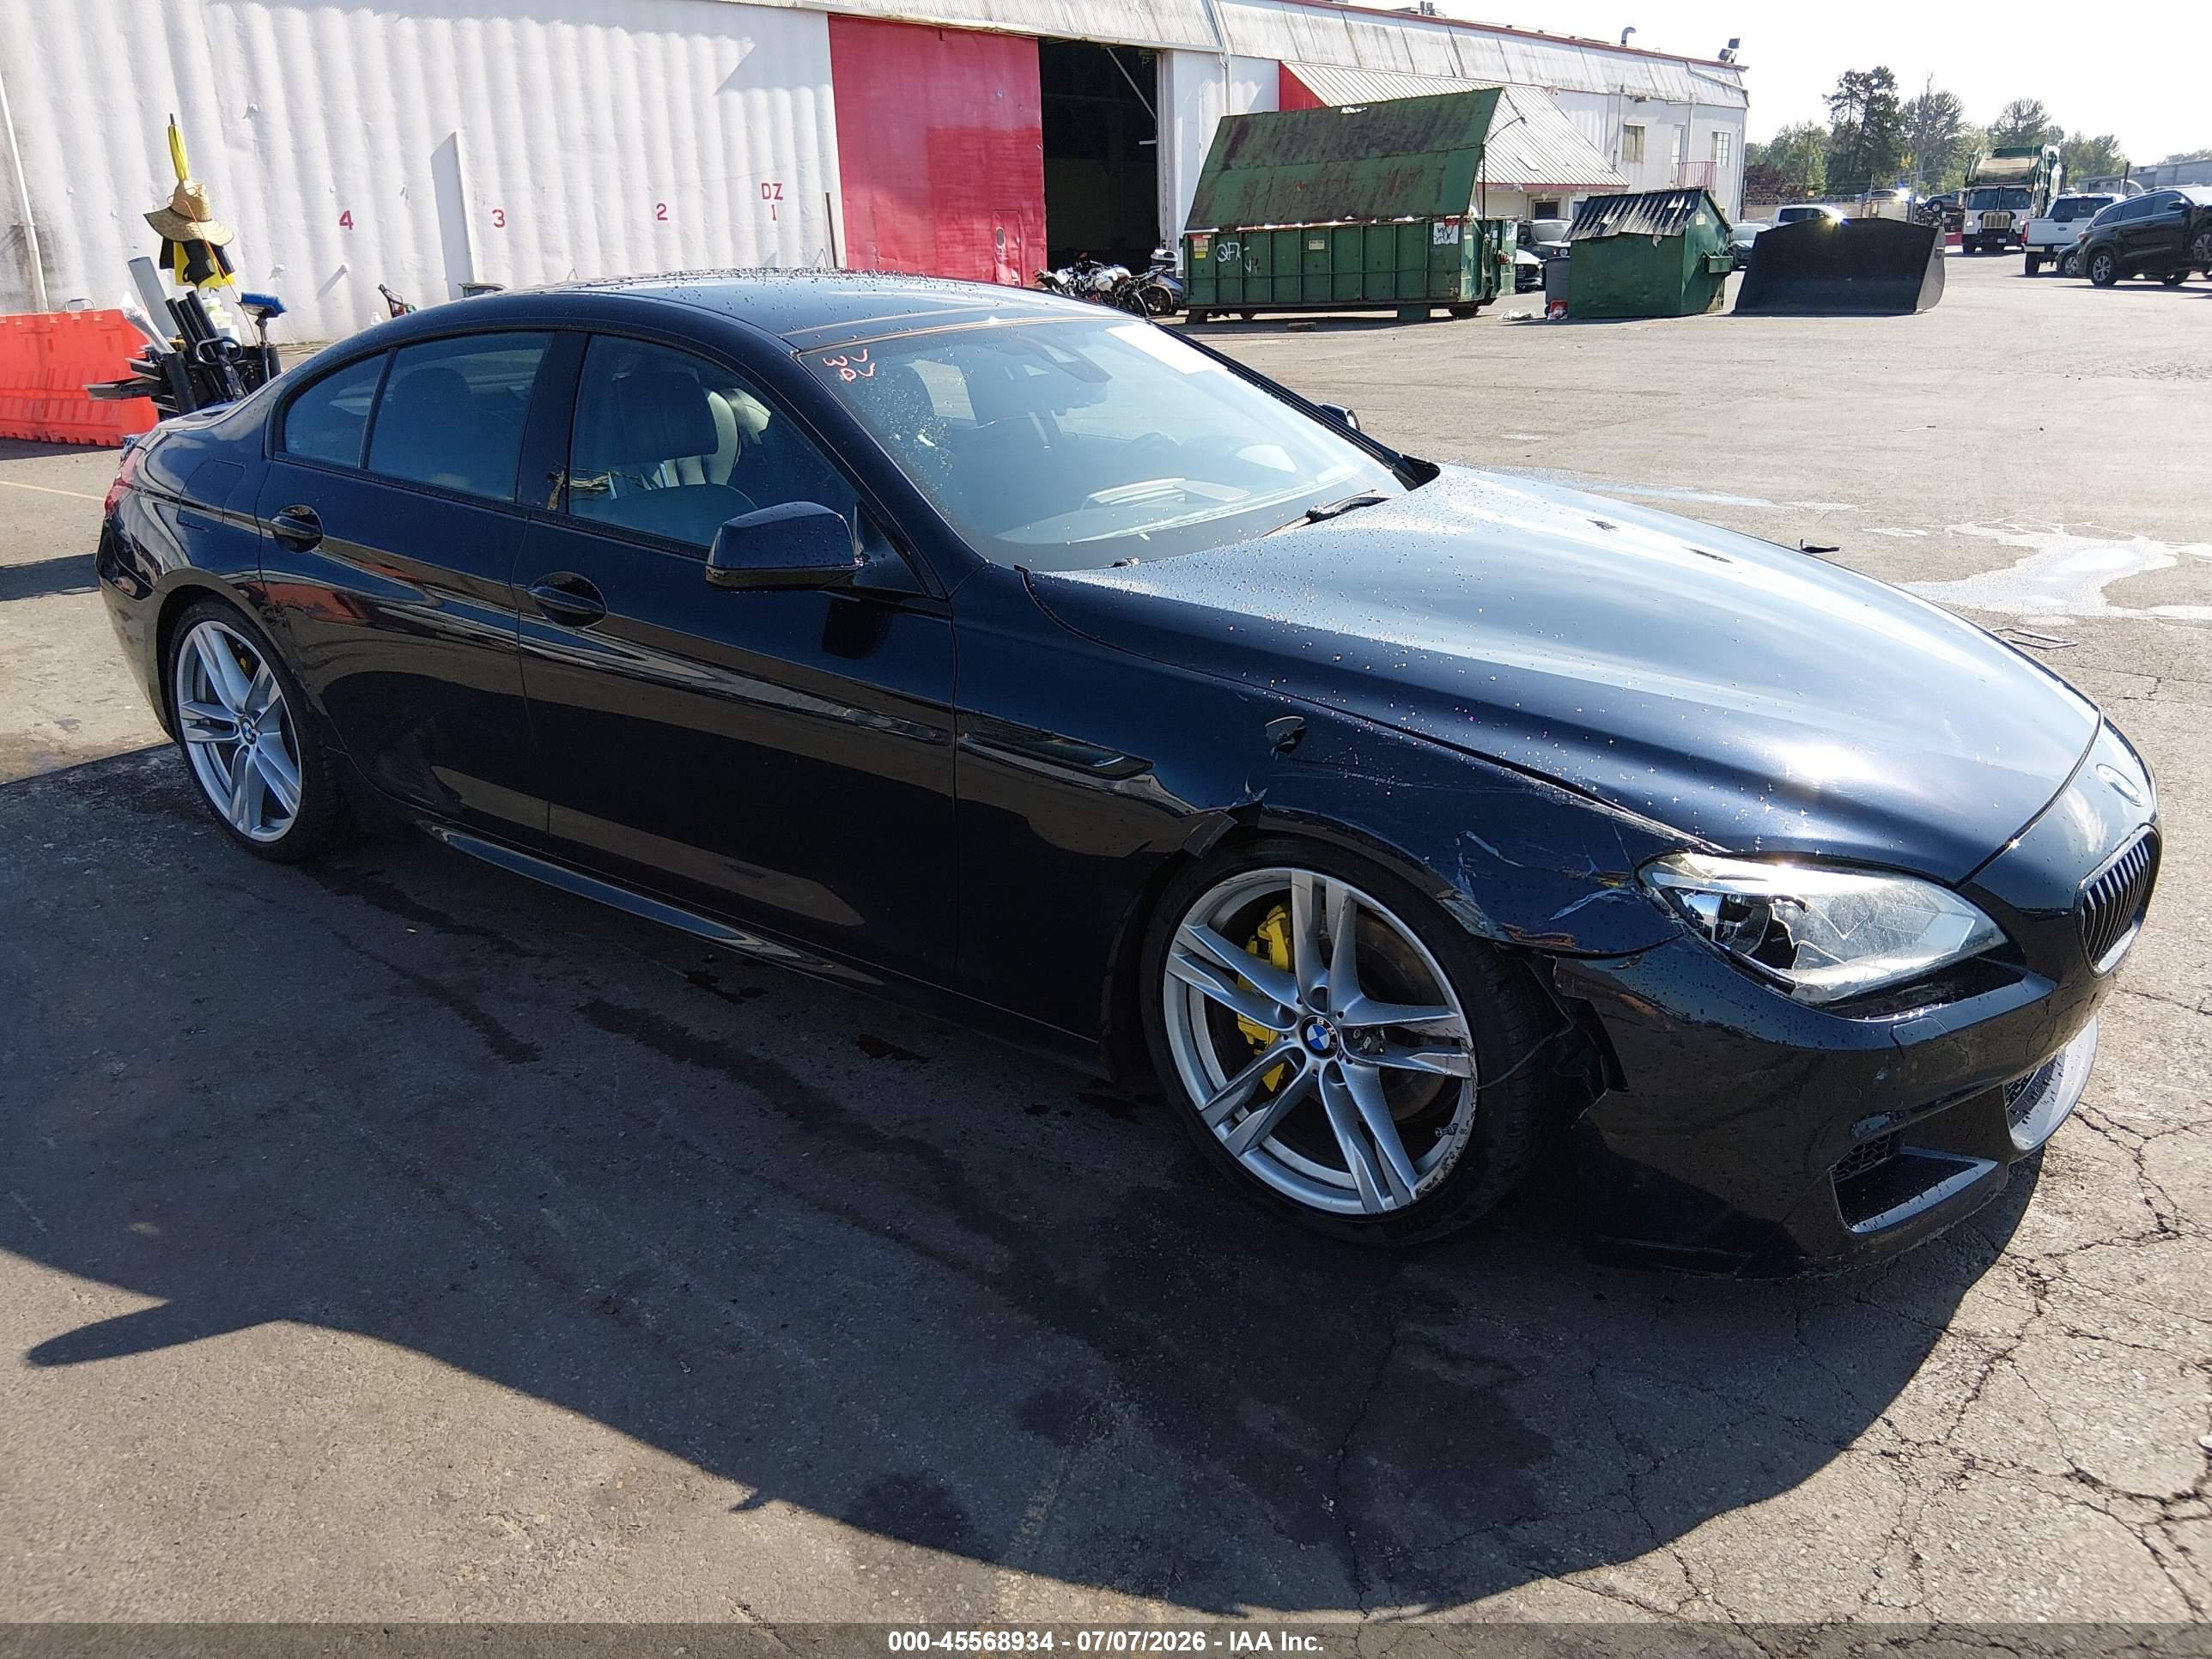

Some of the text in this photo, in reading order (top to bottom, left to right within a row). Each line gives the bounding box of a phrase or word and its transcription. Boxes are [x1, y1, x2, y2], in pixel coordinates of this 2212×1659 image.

[761, 182, 783, 200] DZ
[339, 210, 354, 231] 4
[492, 209, 506, 228] 3
[656, 203, 668, 221] 2
[771, 204, 777, 221] 1
